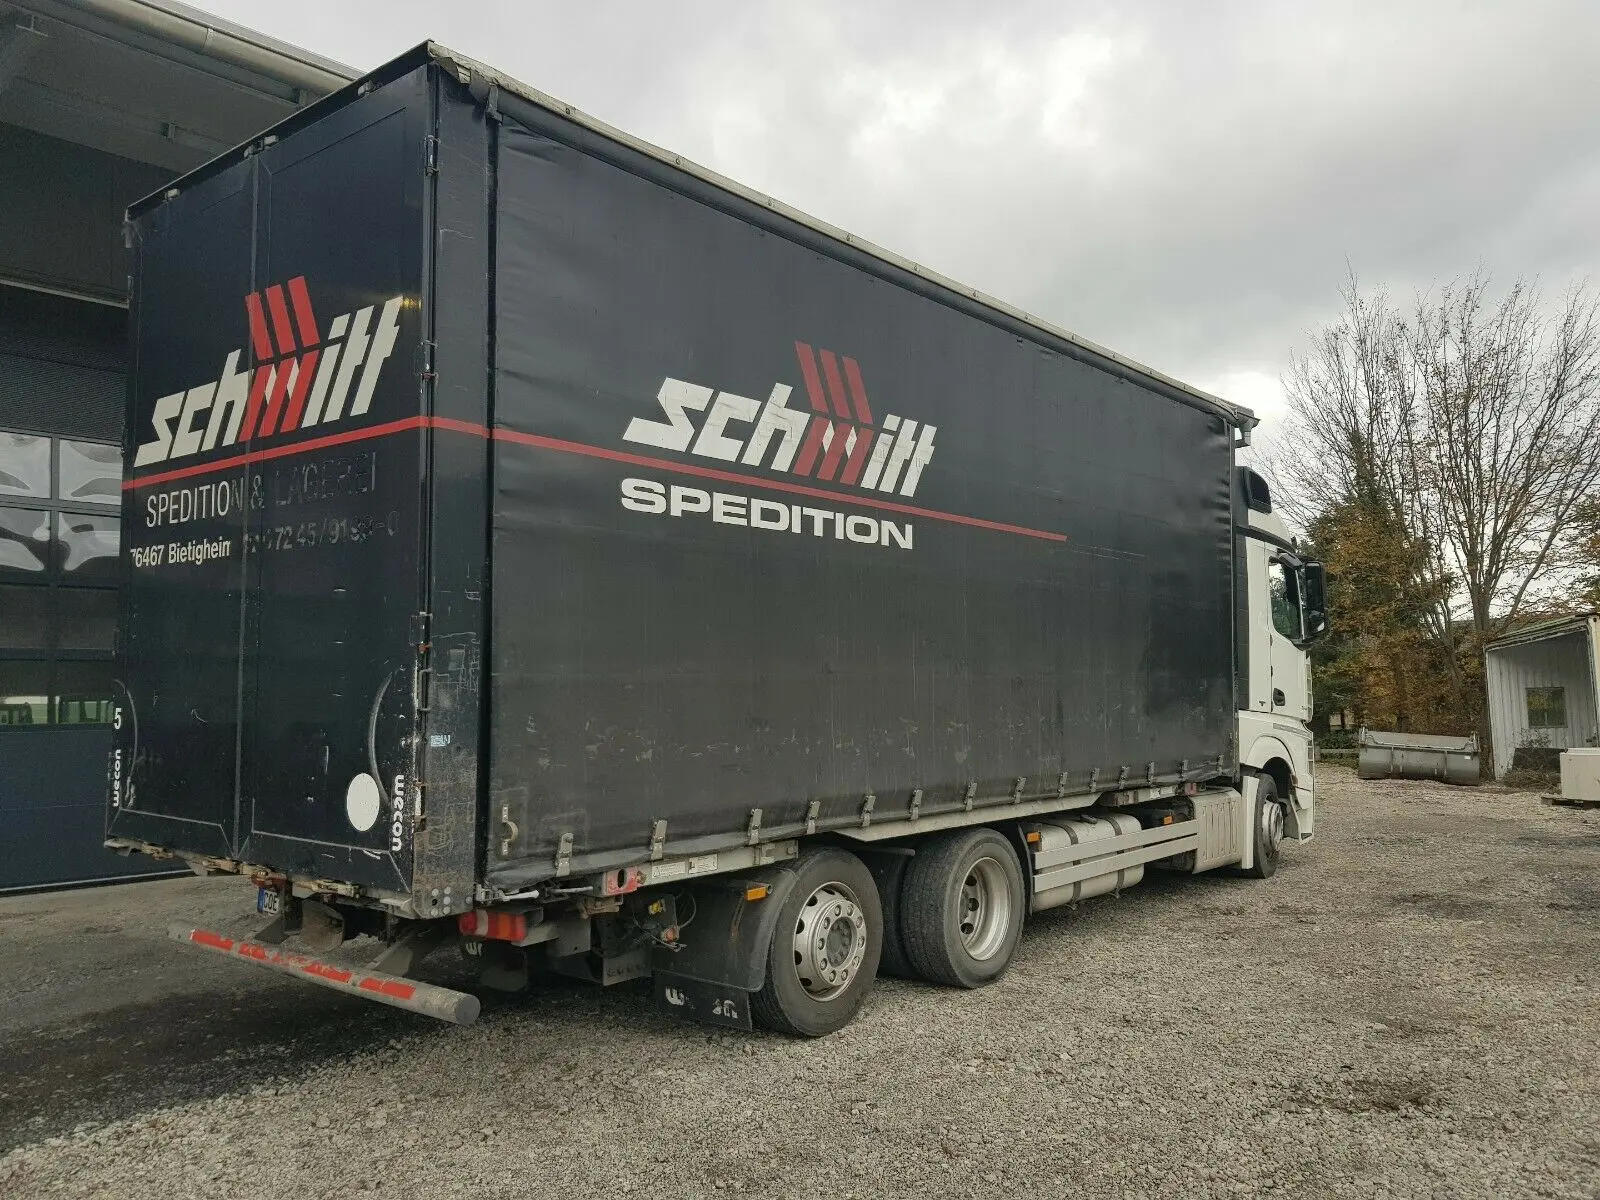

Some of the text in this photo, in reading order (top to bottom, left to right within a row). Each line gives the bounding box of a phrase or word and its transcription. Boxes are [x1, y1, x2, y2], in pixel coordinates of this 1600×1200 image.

[146, 476, 243, 528] SPEDITION
[621, 477, 913, 550] SPEDITION
[391, 774, 405, 851] wecon
